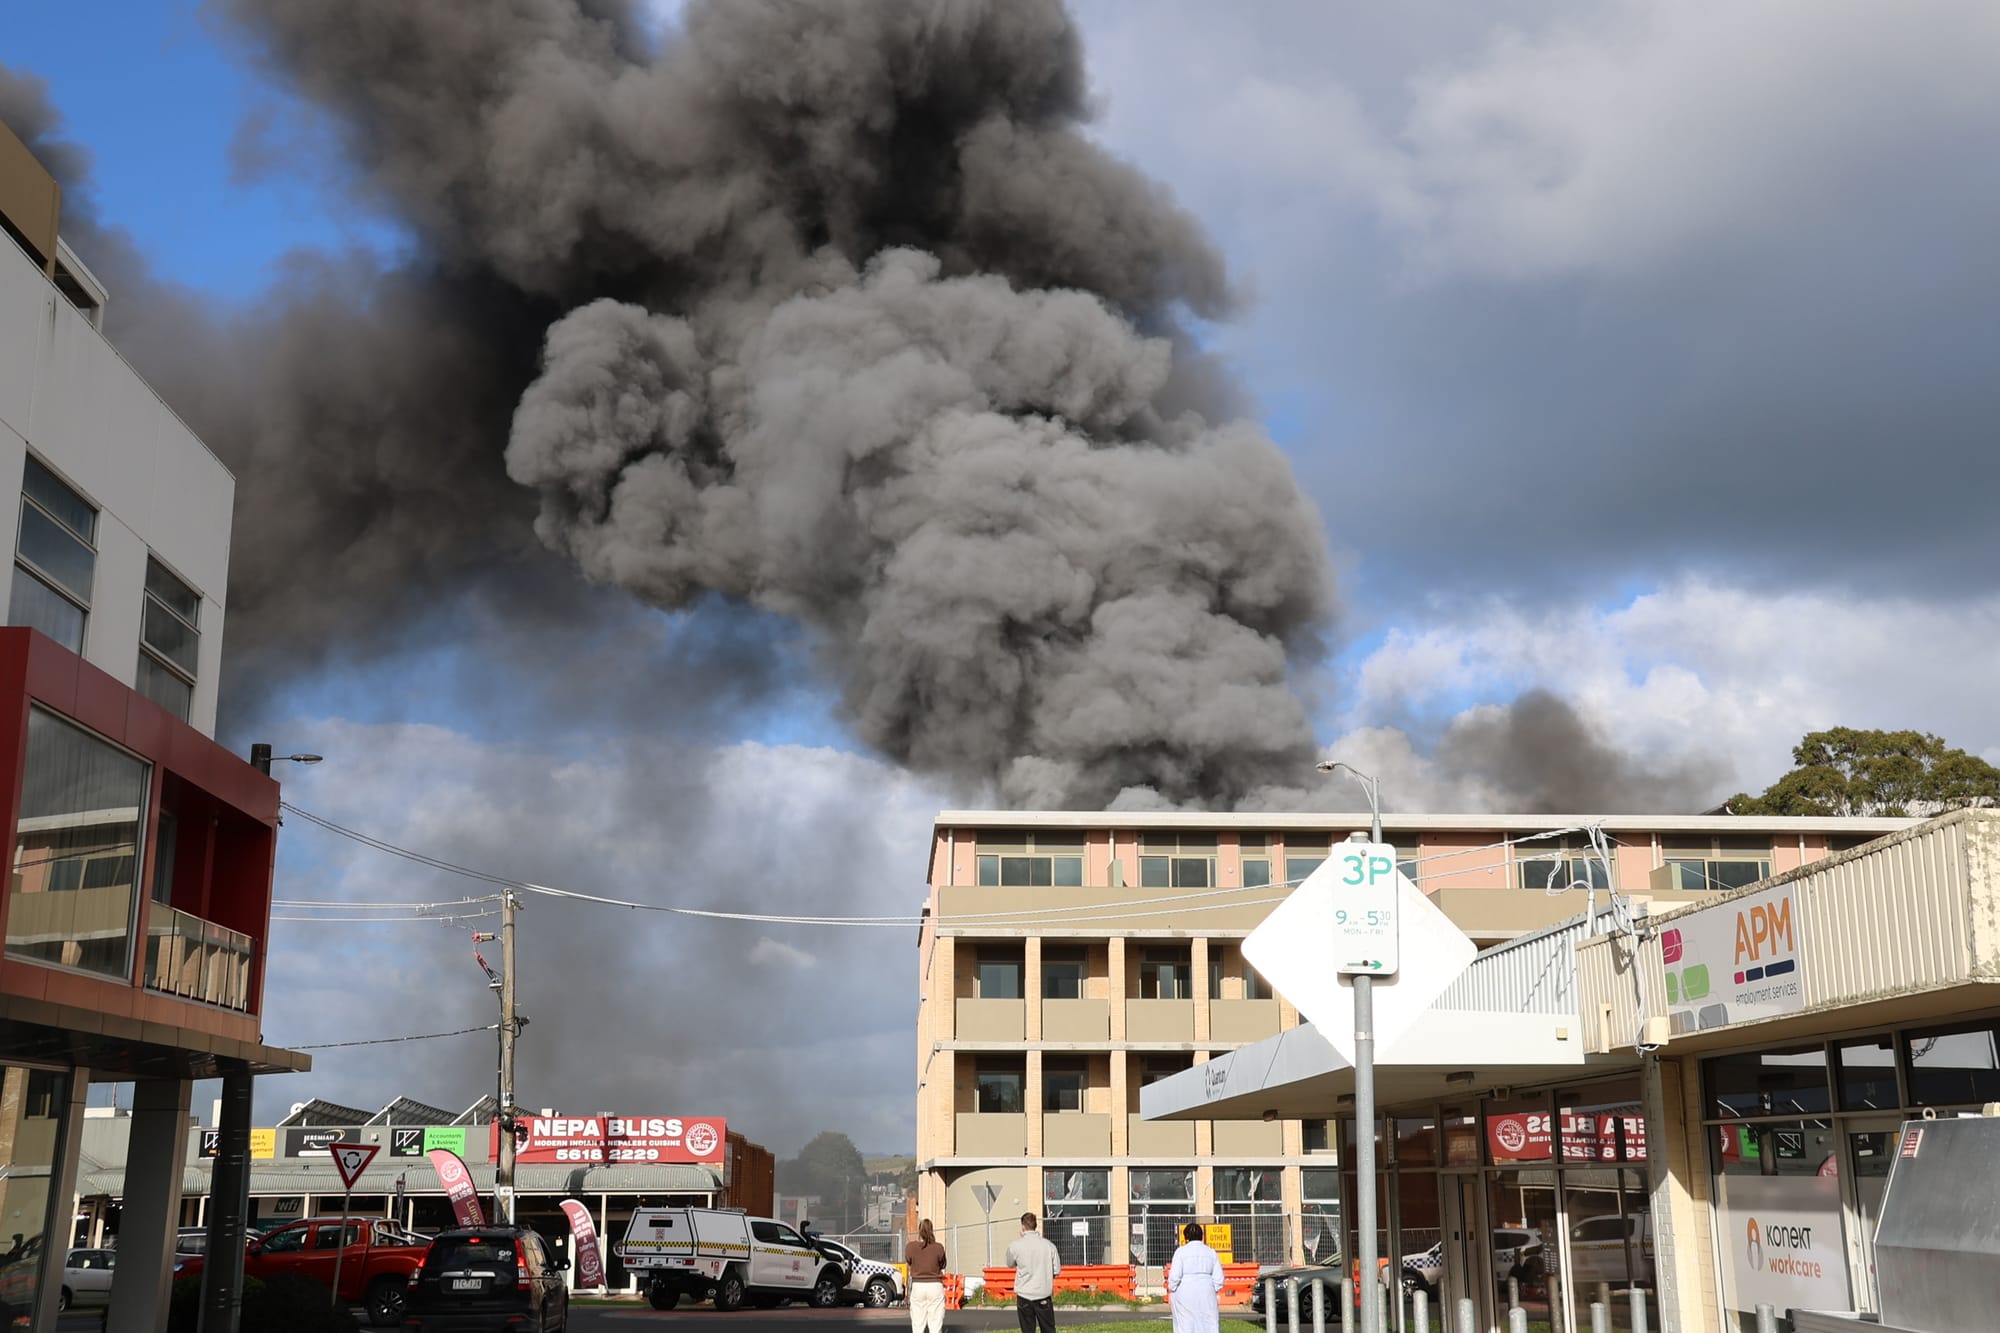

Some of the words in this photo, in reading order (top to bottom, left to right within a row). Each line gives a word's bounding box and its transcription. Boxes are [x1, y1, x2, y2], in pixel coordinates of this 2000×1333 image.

[1343, 855, 1393, 886] 3P
[1734, 897, 1794, 966] APM
[1735, 986, 1771, 1007] employment
[1772, 981, 1798, 1000] services
[533, 1119, 600, 1137] NEPA
[607, 1119, 684, 1137] BLISS
[555, 1149, 604, 1160] 5618
[608, 1149, 660, 1160] 2229
[448, 1181, 470, 1196] NEPA
[1209, 1234, 1228, 1242] OTHER
[1768, 1254, 1823, 1279] workcare
